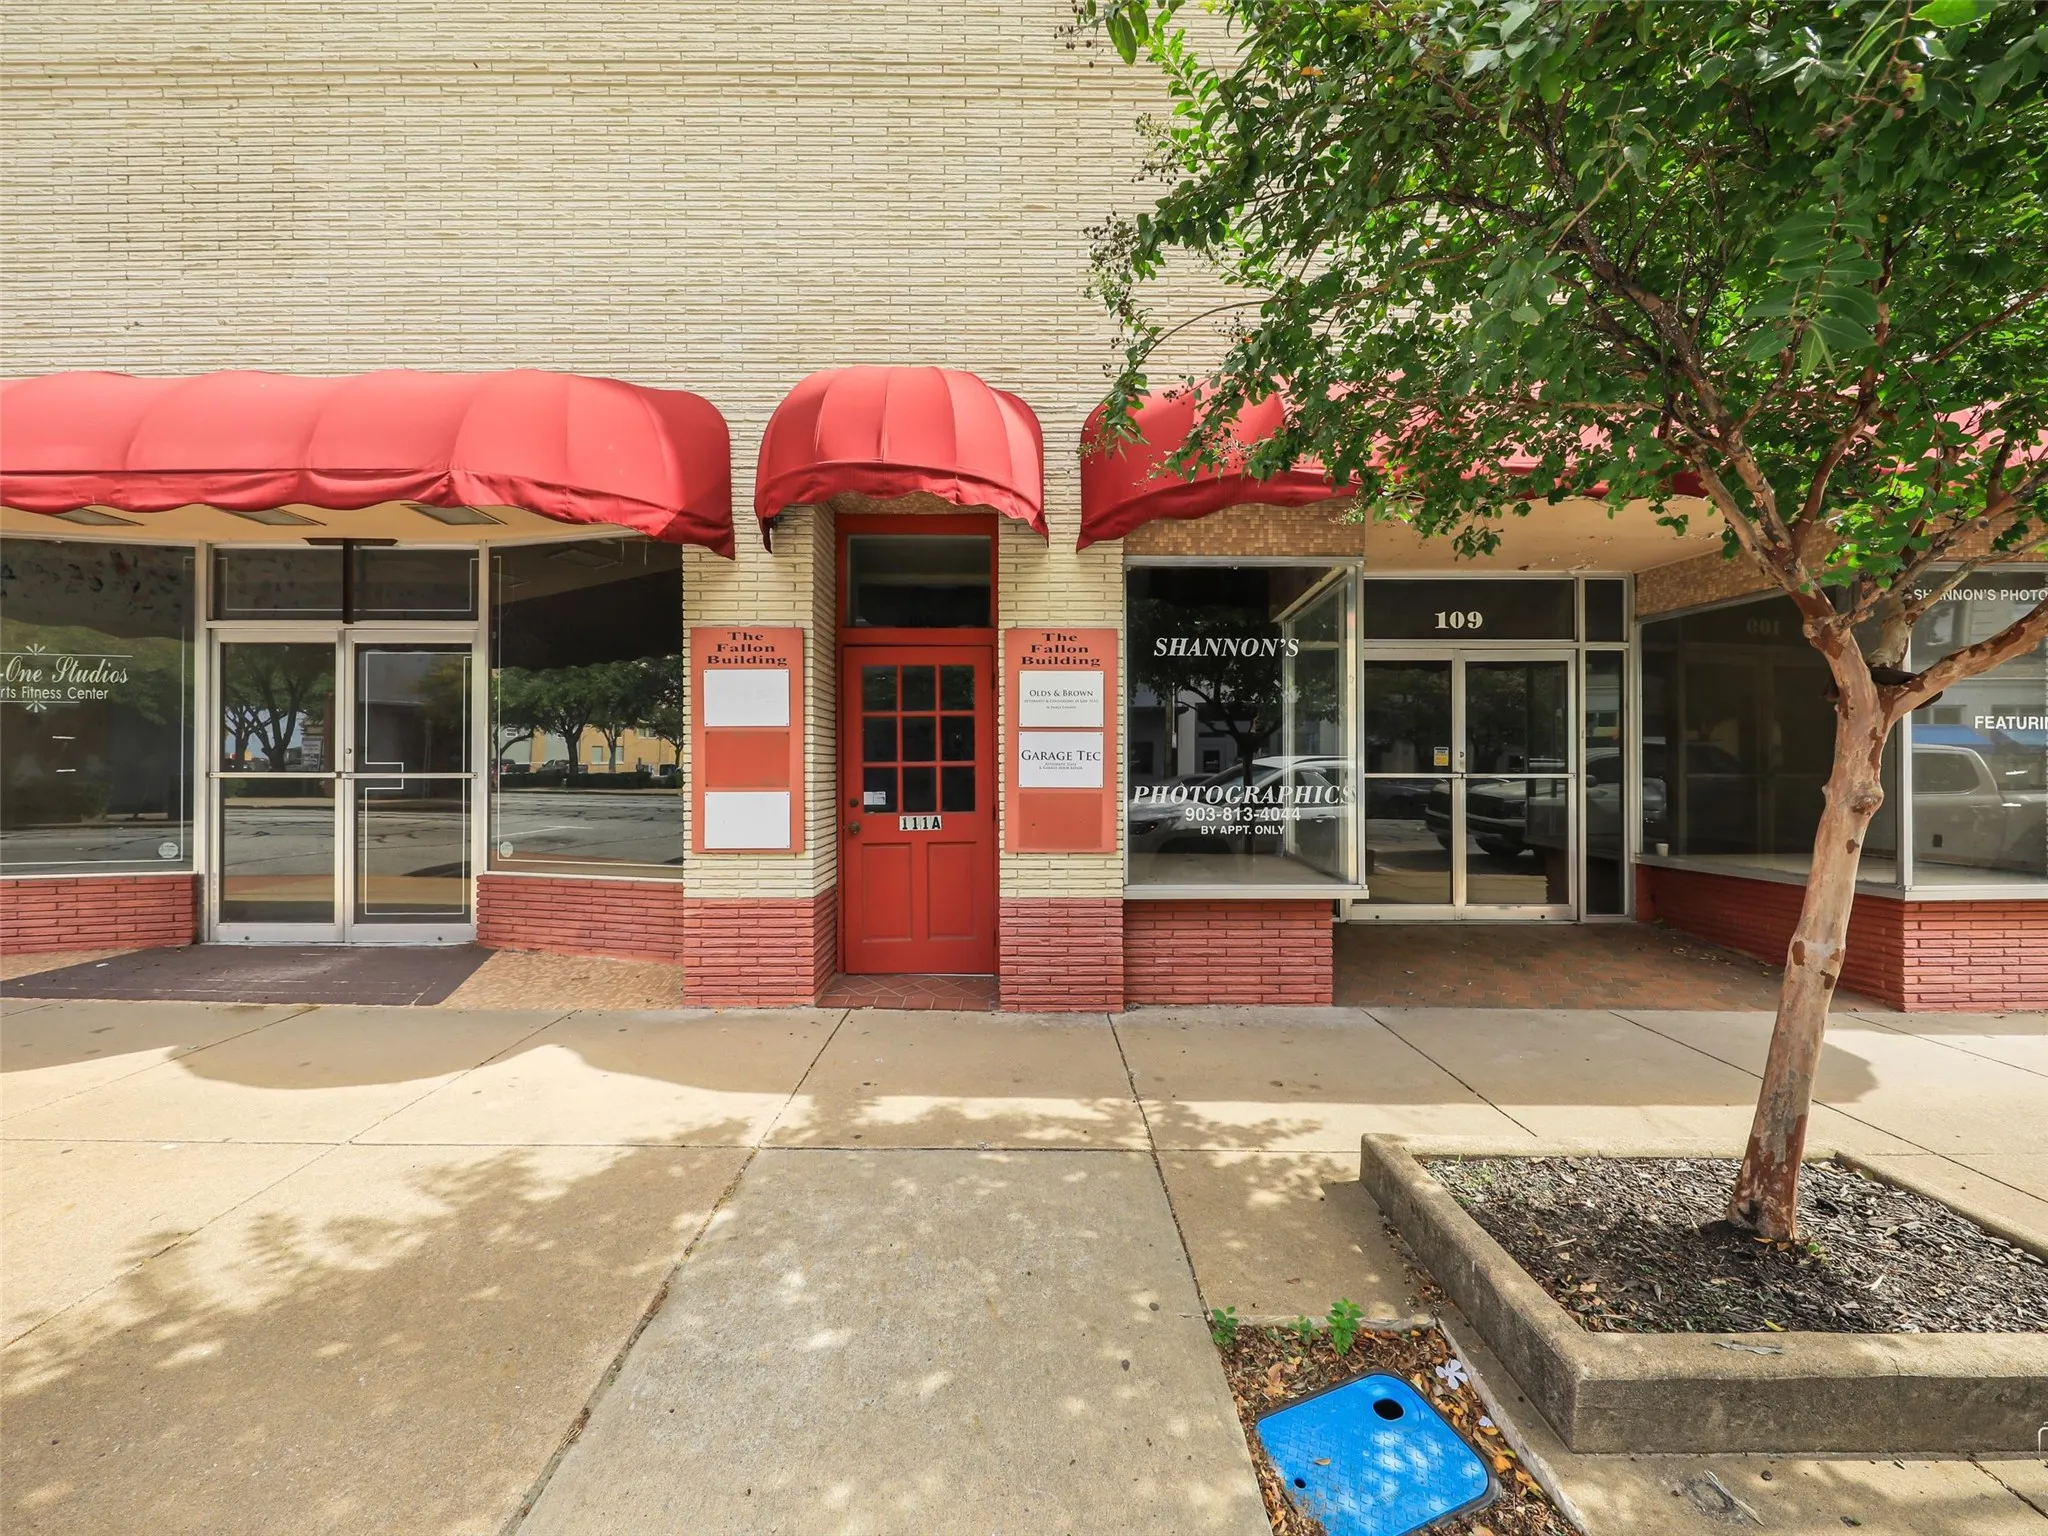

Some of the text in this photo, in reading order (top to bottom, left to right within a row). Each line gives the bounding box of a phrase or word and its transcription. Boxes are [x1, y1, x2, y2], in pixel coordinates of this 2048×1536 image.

[1913, 588, 1996, 601] SHNNON'S
[1434, 611, 1483, 629] 109
[727, 632, 764, 641] The
[1041, 633, 1078, 642] The
[716, 643, 775, 653] Fallon
[1030, 644, 1089, 653] Fallon
[1153, 637, 1300, 657] SHANNON'S
[707, 655, 788, 667] Building
[1021, 656, 1101, 668] Building
[52, 656, 129, 684] Studios
[21, 686, 62, 699] Fitness
[67, 686, 109, 700] Center
[1053, 689, 1060, 697] &
[1076, 750, 1101, 761] TEC
[1131, 785, 1357, 805] PHOTOGRAPHICS
[1185, 806, 1301, 822] 903-813-4044
[902, 816, 941, 830] 111A
[1200, 825, 1286, 835] BY APPT. ONLY
